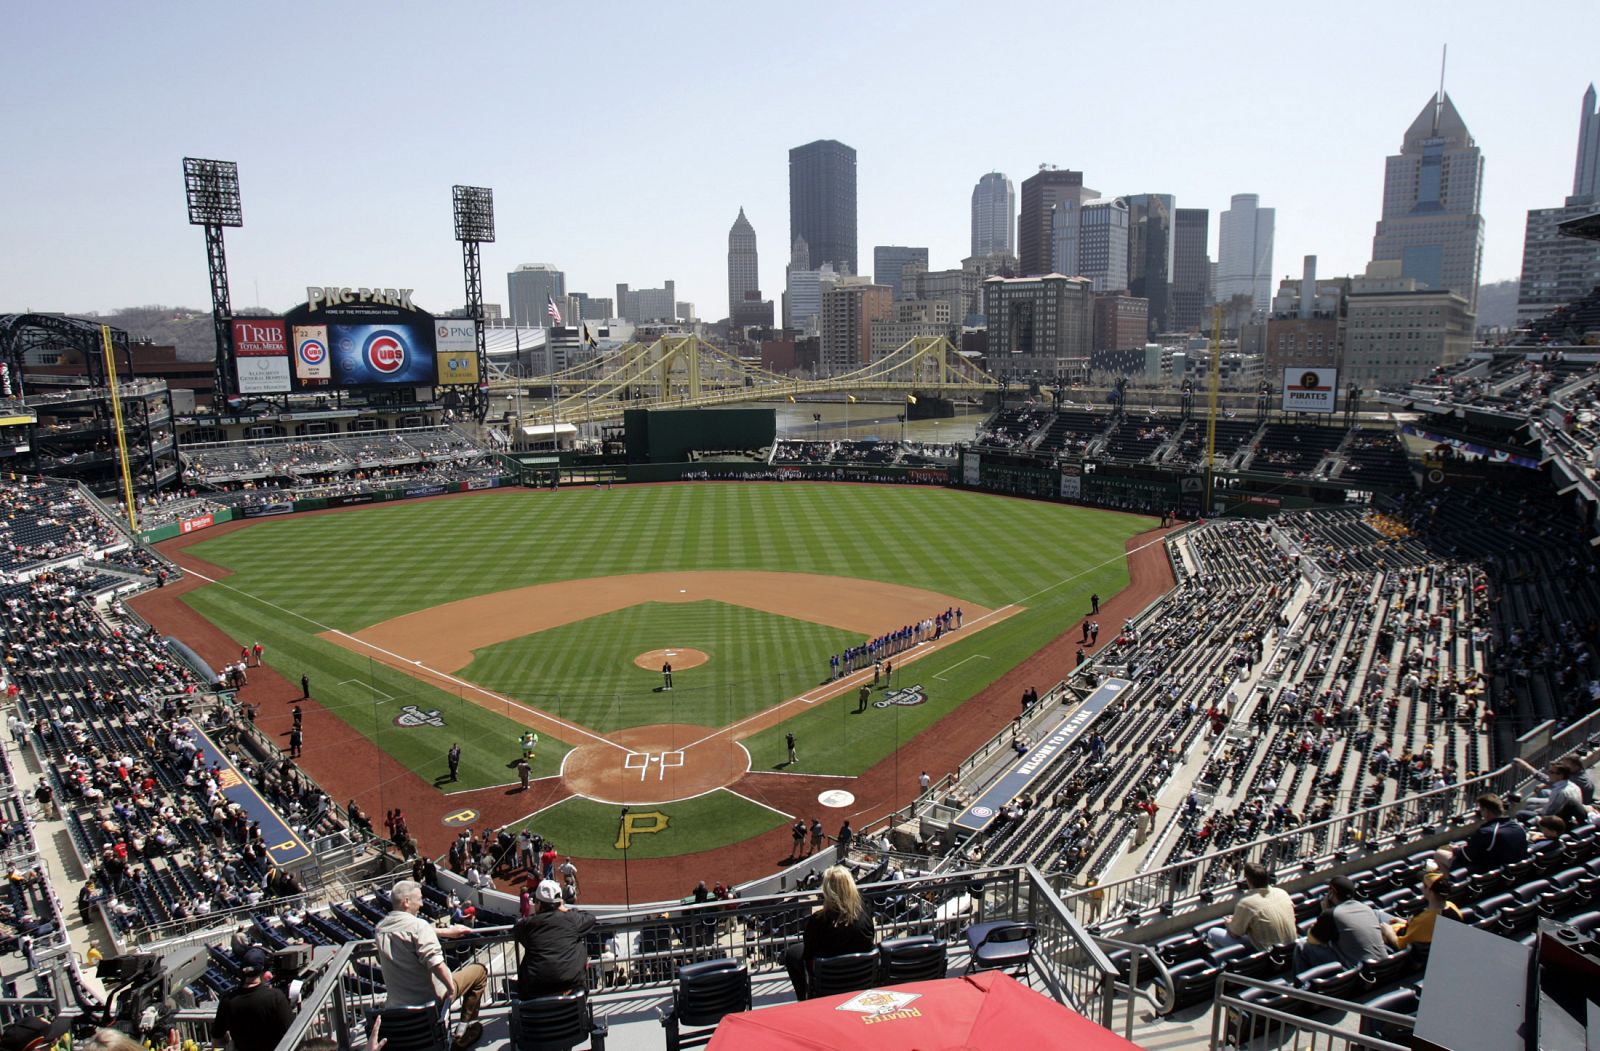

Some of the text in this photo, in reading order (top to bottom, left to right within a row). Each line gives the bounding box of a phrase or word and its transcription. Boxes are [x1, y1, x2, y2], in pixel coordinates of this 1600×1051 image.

[307, 286, 417, 313] PNC PARK
[236, 324, 283, 342] TRIB
[450, 327, 474, 337] PNC
[239, 342, 285, 350] TOTAL MEDIA
[1290, 392, 1328, 400] PIRATES
[1016, 709, 1093, 776] WELCOME TO PNC PARK
[444, 809, 476, 823] P
[613, 809, 672, 850] P
[861, 1006, 923, 1025] PIRATES
